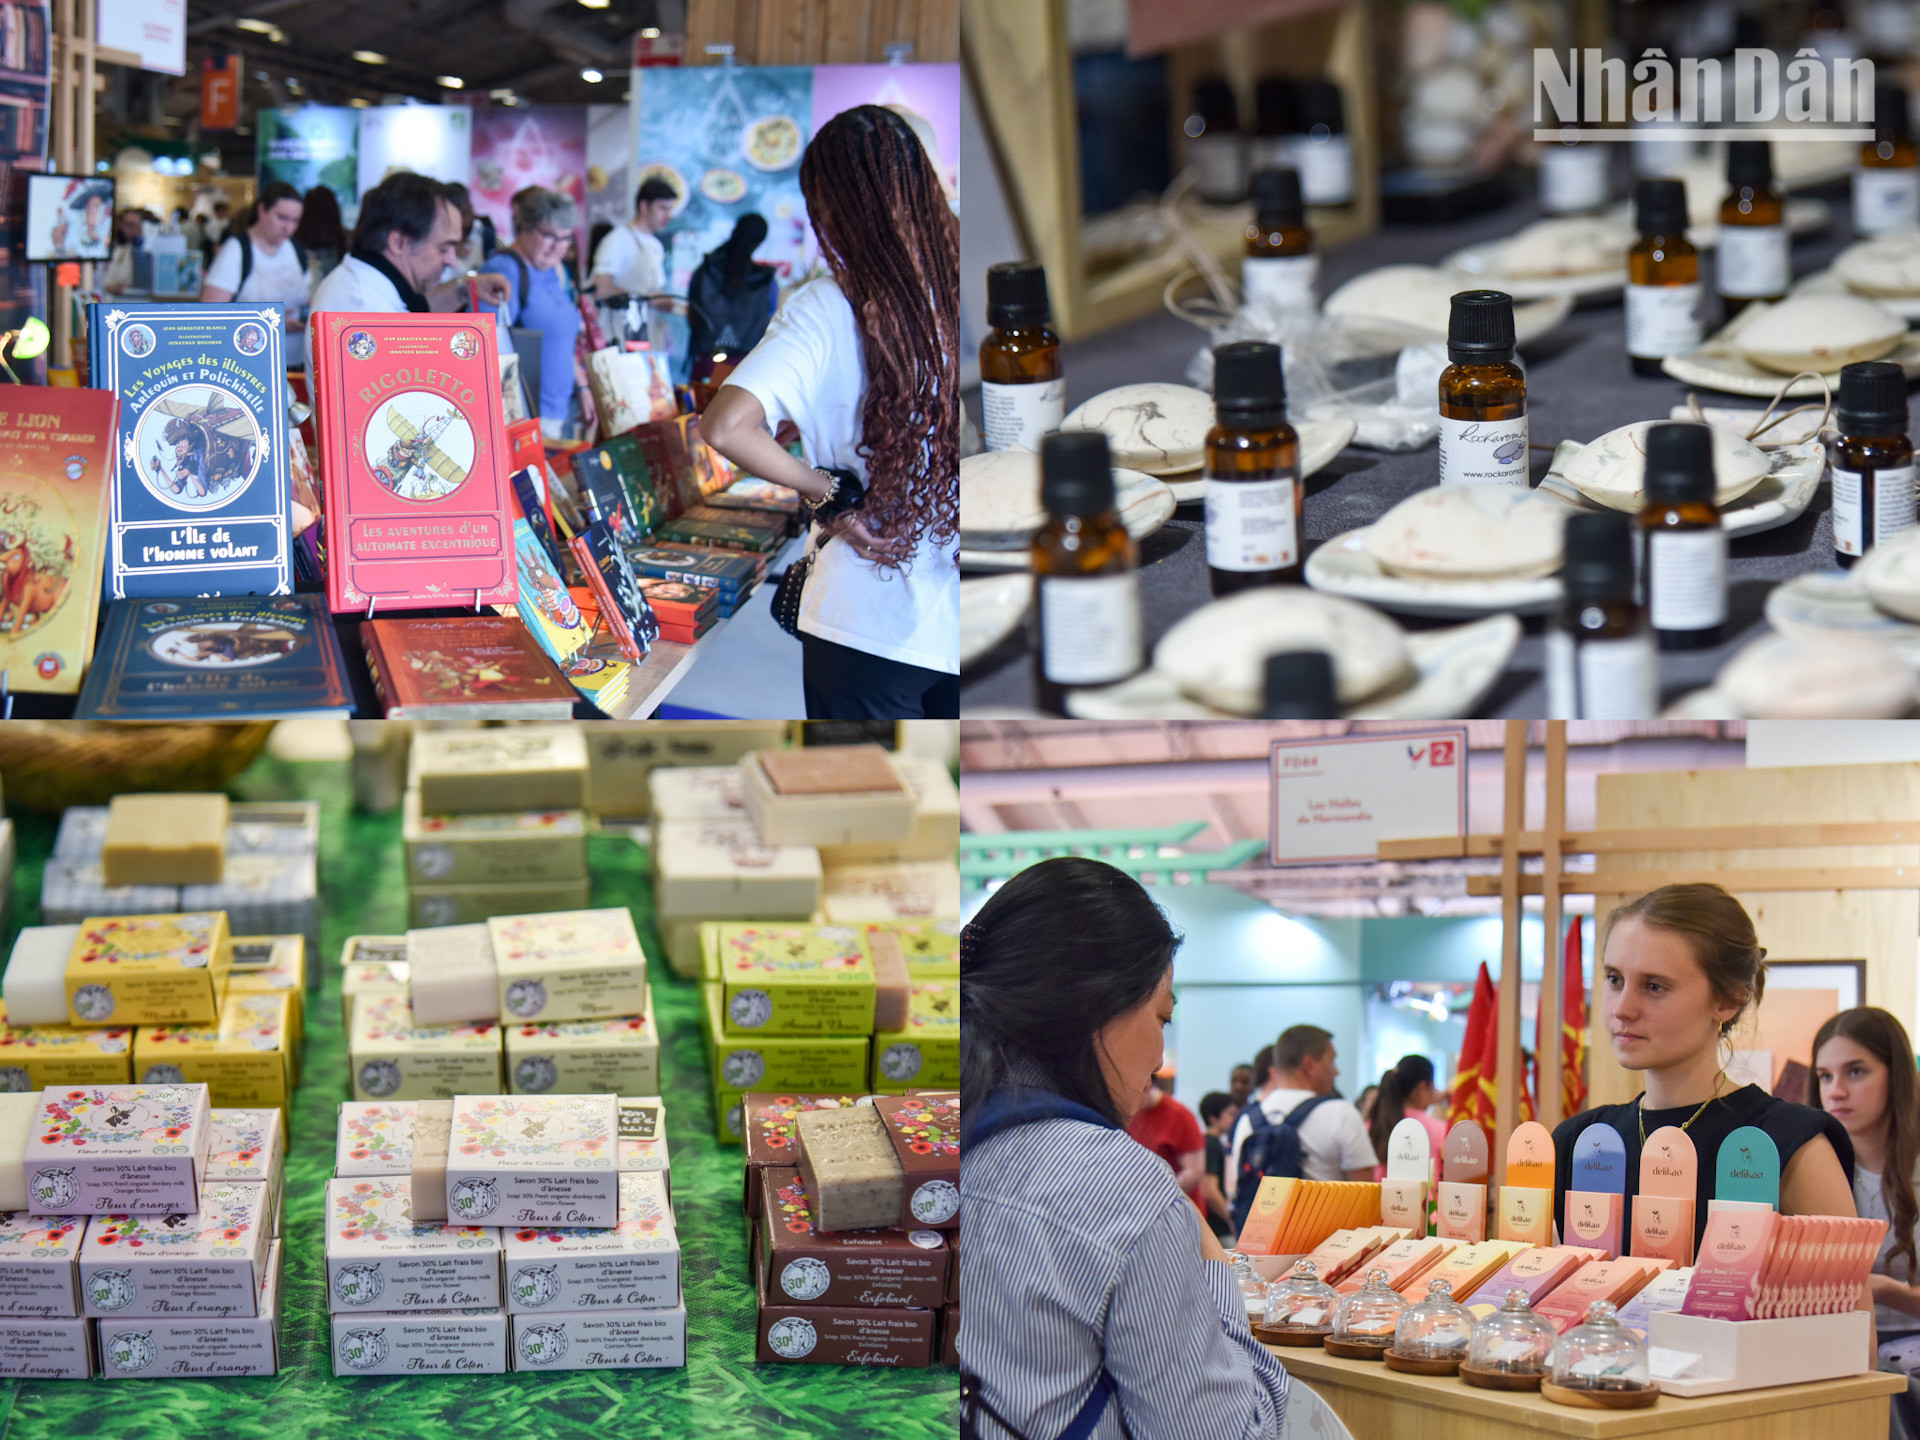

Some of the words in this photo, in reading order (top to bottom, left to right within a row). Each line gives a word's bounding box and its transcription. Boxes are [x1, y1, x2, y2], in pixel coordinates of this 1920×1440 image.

[358, 368, 476, 404] RIGOLETTO
[1517, 1159, 1543, 1168] delikao
[1584, 1162, 1613, 1172] delikao
[1652, 1167, 1682, 1177] delikao
[1730, 1169, 1763, 1179] delikao
[541, 1185, 572, 1193] d'ânesse
[95, 1197, 128, 1209] Fleur
[130, 1198, 180, 1215] d'oranger
[517, 1209, 549, 1222] Fleur
[551, 1210, 563, 1222] de
[565, 1209, 595, 1223] Coton
[1511, 1215, 1531, 1223] delikao
[1578, 1221, 1600, 1229] delikao
[1645, 1228, 1668, 1236] delikao
[173, 1267, 188, 1275] 30%
[402, 1293, 435, 1305] Fleur
[437, 1293, 448, 1304] de
[451, 1291, 480, 1305] Coton
[578, 1293, 610, 1306] Fleur
[612, 1294, 624, 1304] de
[627, 1291, 655, 1305] Coton
[859, 1291, 912, 1306] Exfoliant
[152, 1300, 184, 1313] Fleur
[186, 1300, 237, 1317] d'oranger
[888, 1319, 904, 1327] frais
[170, 1328, 190, 1336] Savon
[225, 1327, 241, 1335] frais
[242, 1327, 254, 1335] bio
[586, 1352, 617, 1365] Fleur
[620, 1354, 630, 1364] de
[634, 1351, 662, 1365] Coton
[847, 1350, 899, 1365] Exfoliant
[171, 1360, 204, 1373] Fleur
[206, 1360, 257, 1377] d'oranger
[407, 1357, 438, 1370] Fleur
[441, 1358, 452, 1369] de
[455, 1357, 484, 1371] Coton
